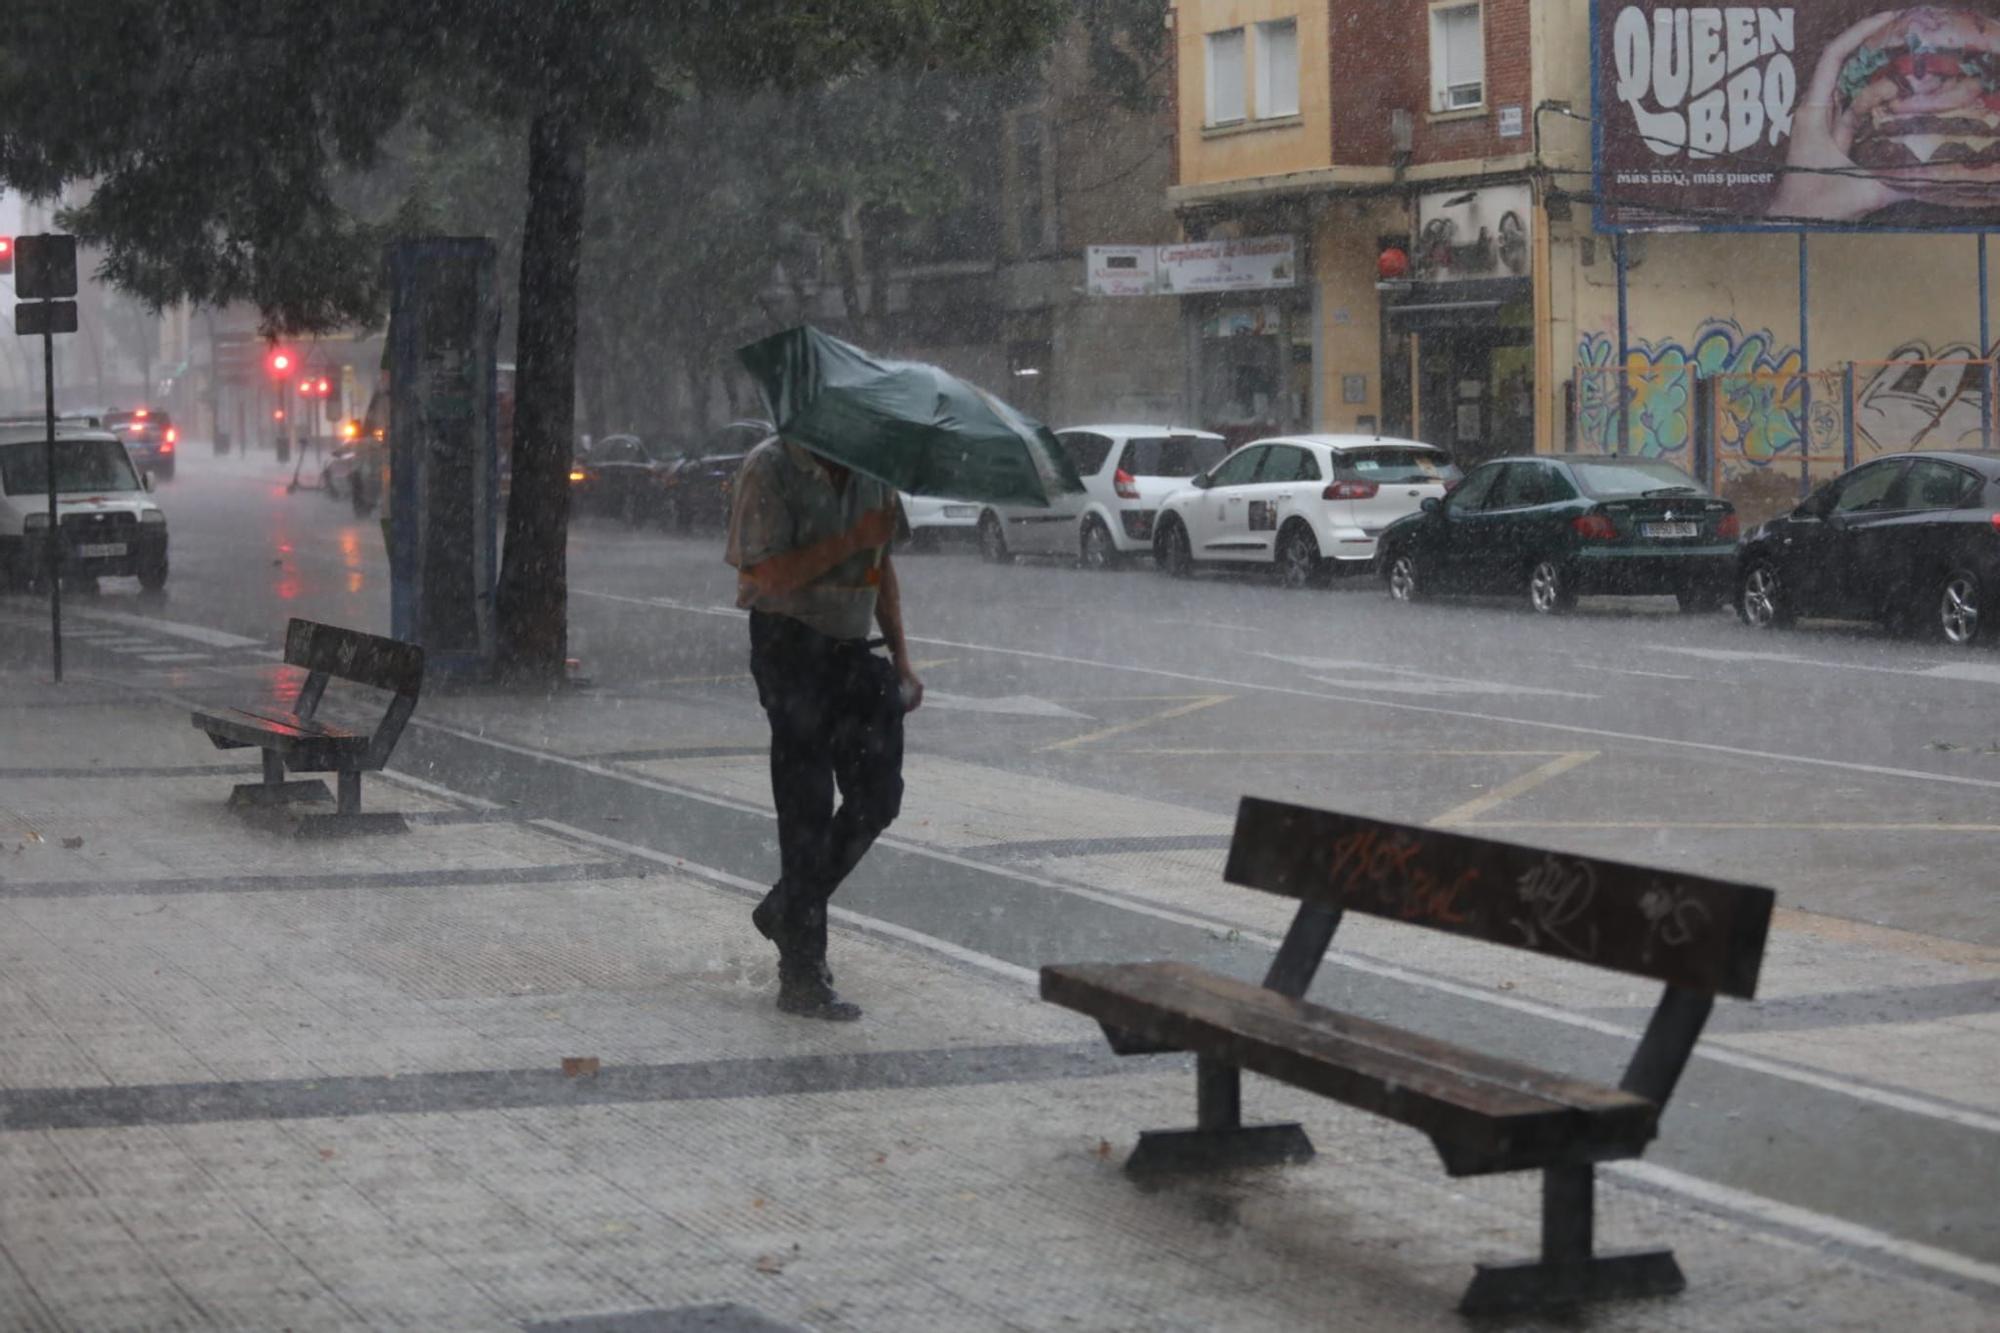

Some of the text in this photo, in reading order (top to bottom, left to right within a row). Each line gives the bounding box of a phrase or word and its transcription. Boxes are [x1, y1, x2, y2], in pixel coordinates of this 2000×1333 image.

[1614, 6, 1796, 156] QUEEN
[1688, 54, 1796, 158] BBQ
[1617, 168, 1648, 185] Más
[1693, 168, 1724, 184] más
